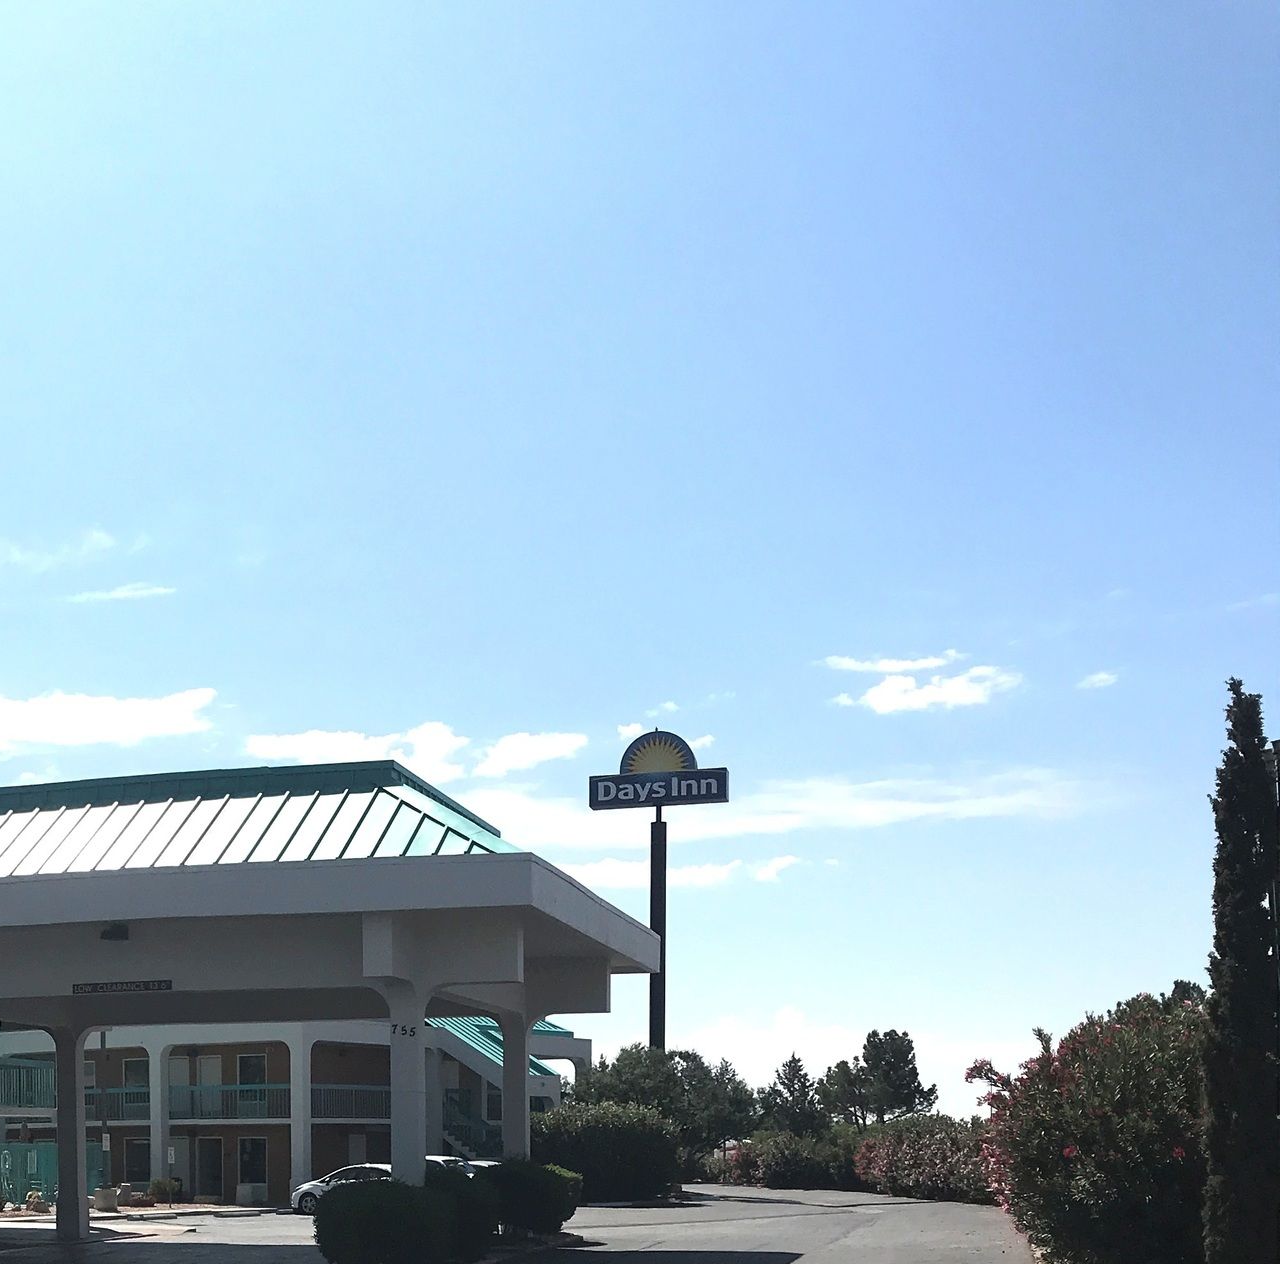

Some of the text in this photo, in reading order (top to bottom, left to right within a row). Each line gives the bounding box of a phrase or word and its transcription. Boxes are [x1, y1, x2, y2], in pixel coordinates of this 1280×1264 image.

[597, 776, 718, 802] Days Inn
[74, 984, 94, 993] LOW
[97, 982, 145, 992] CLEARANCE
[391, 1023, 417, 1037] 755
